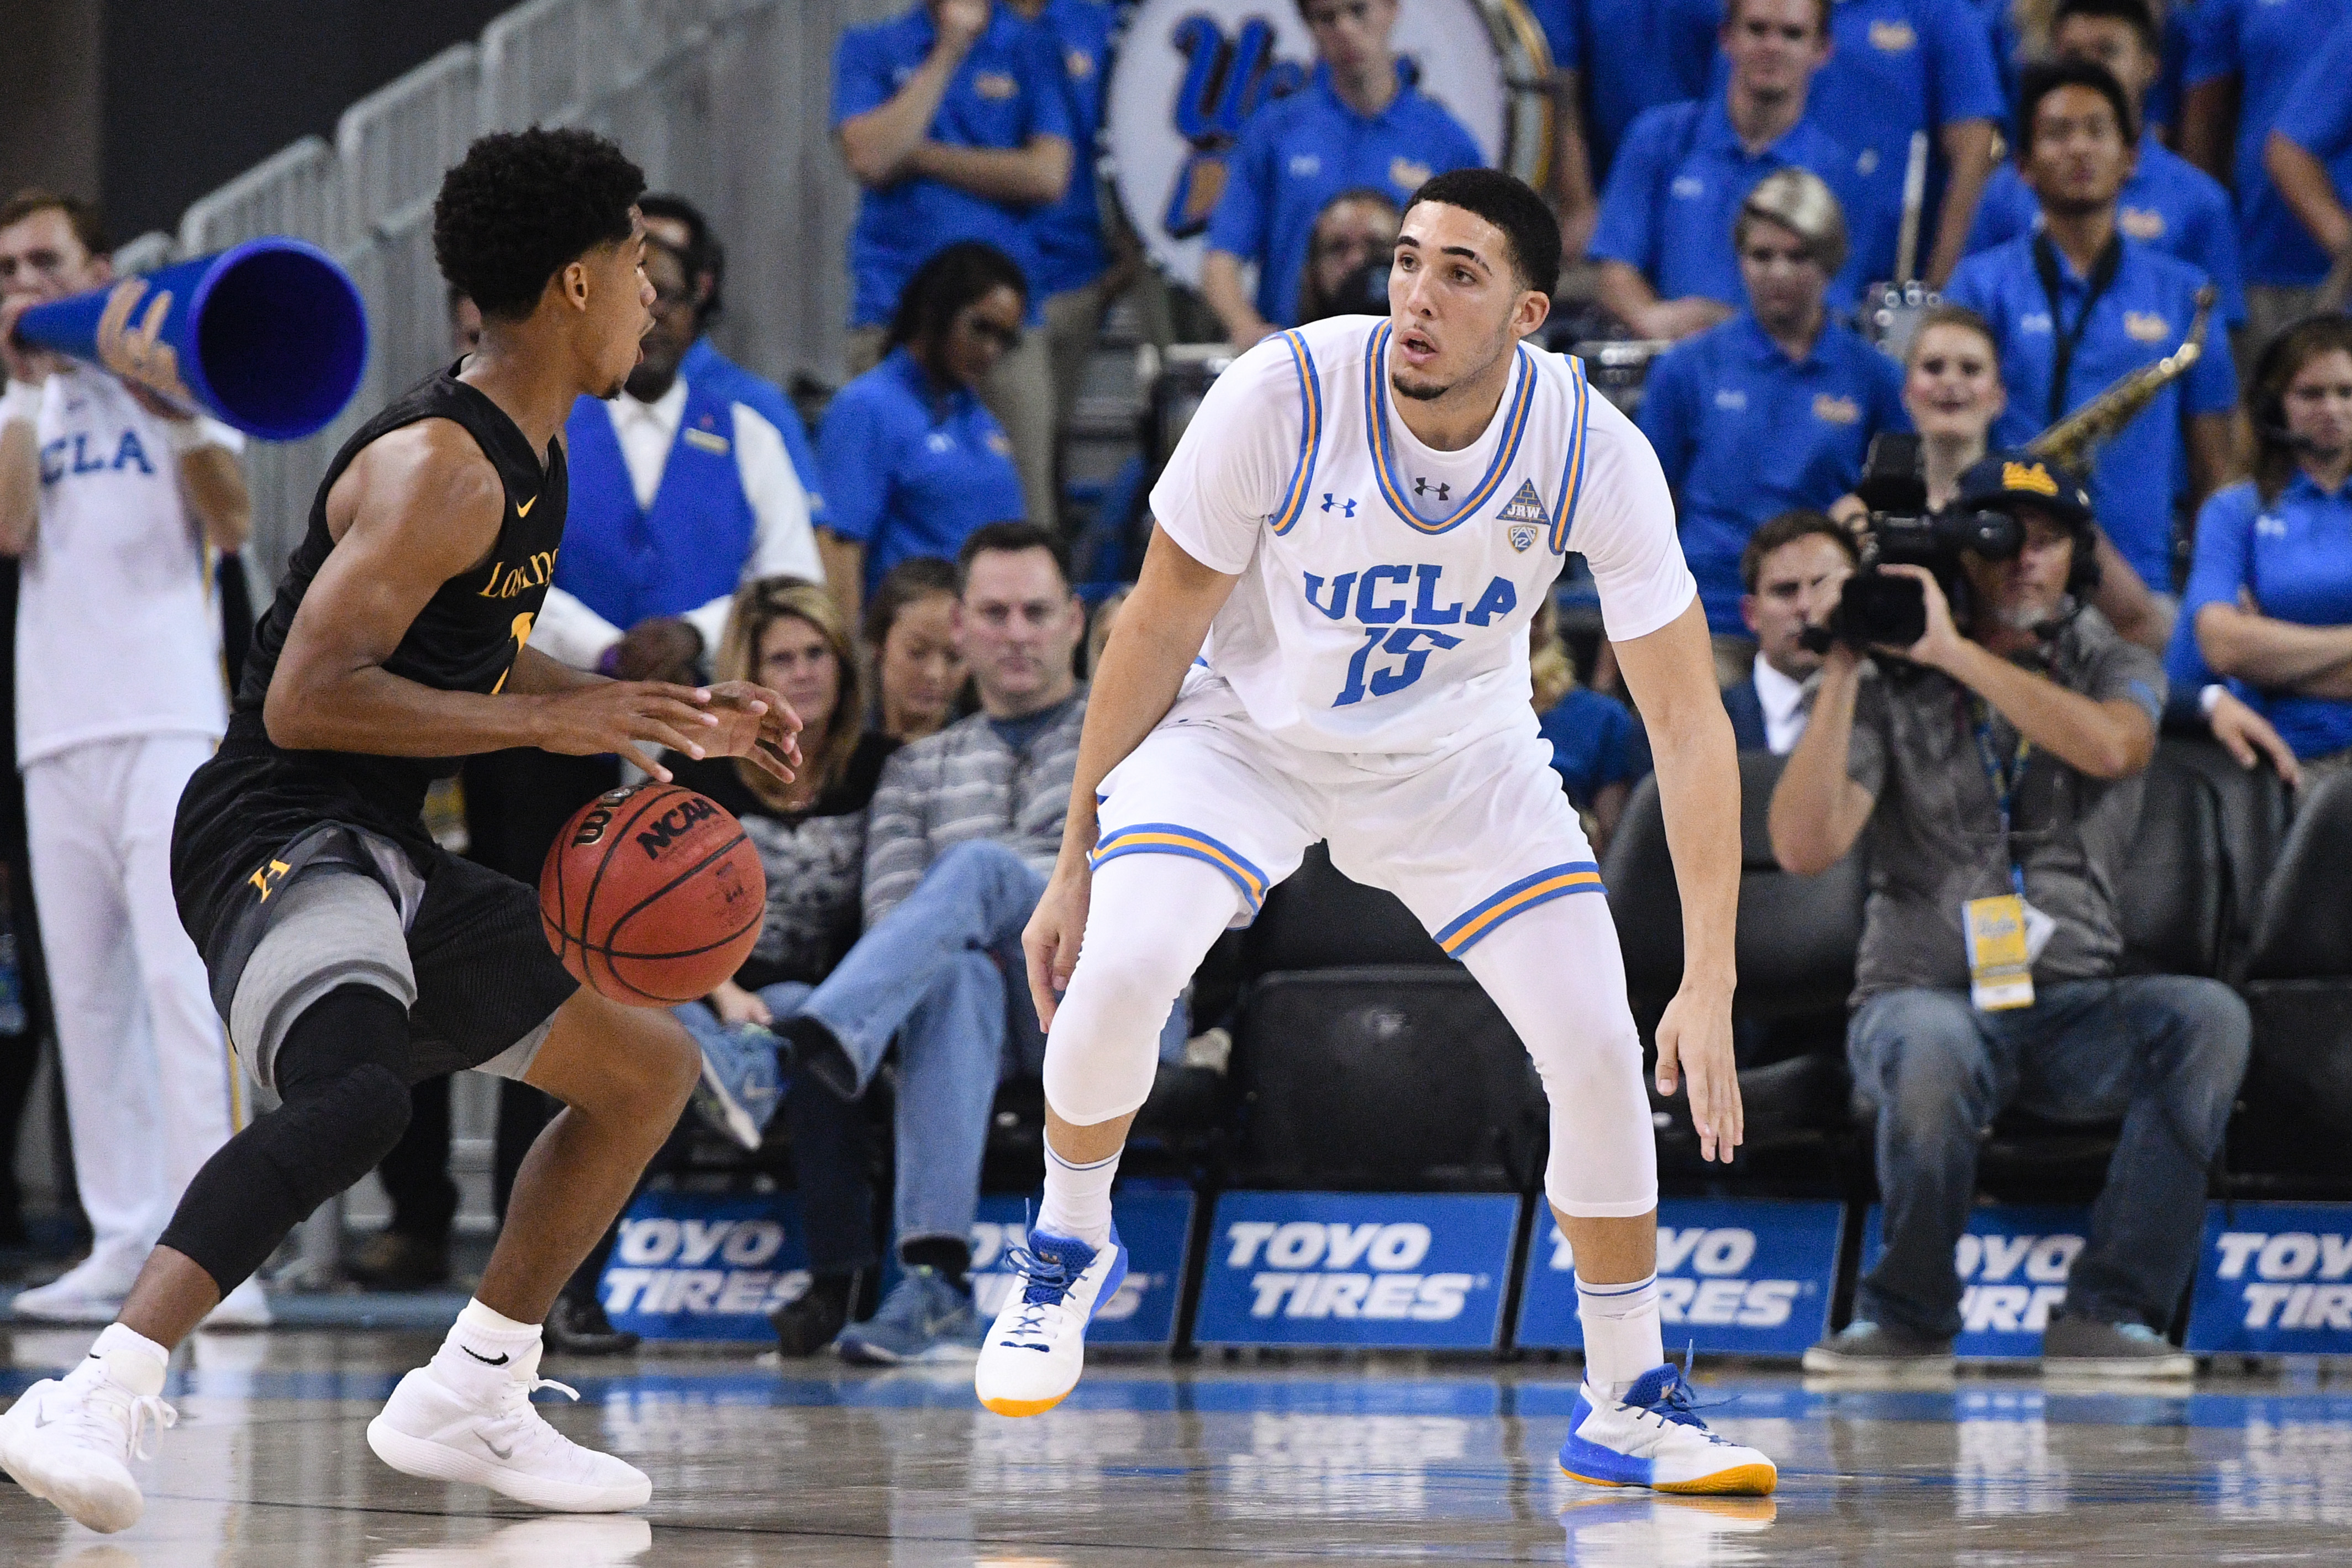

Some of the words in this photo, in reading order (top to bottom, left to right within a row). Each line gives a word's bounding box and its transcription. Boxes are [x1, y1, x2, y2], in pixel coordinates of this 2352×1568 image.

[40, 428, 157, 486] CLA
[1507, 504, 1541, 519] JRW
[1514, 536, 1529, 548] 12
[1303, 563, 1518, 627] UCLA
[1330, 627, 1465, 708] 15
[636, 797, 720, 860] NCAA
[619, 1218, 785, 1267] OYO
[1227, 1220, 1432, 1270] TOYO
[2216, 1232, 2352, 1280] TOY
[1250, 1271, 1474, 1320] TIRES
[1656, 1277, 1801, 1327] RES
[2242, 1282, 2352, 1330] TIR
